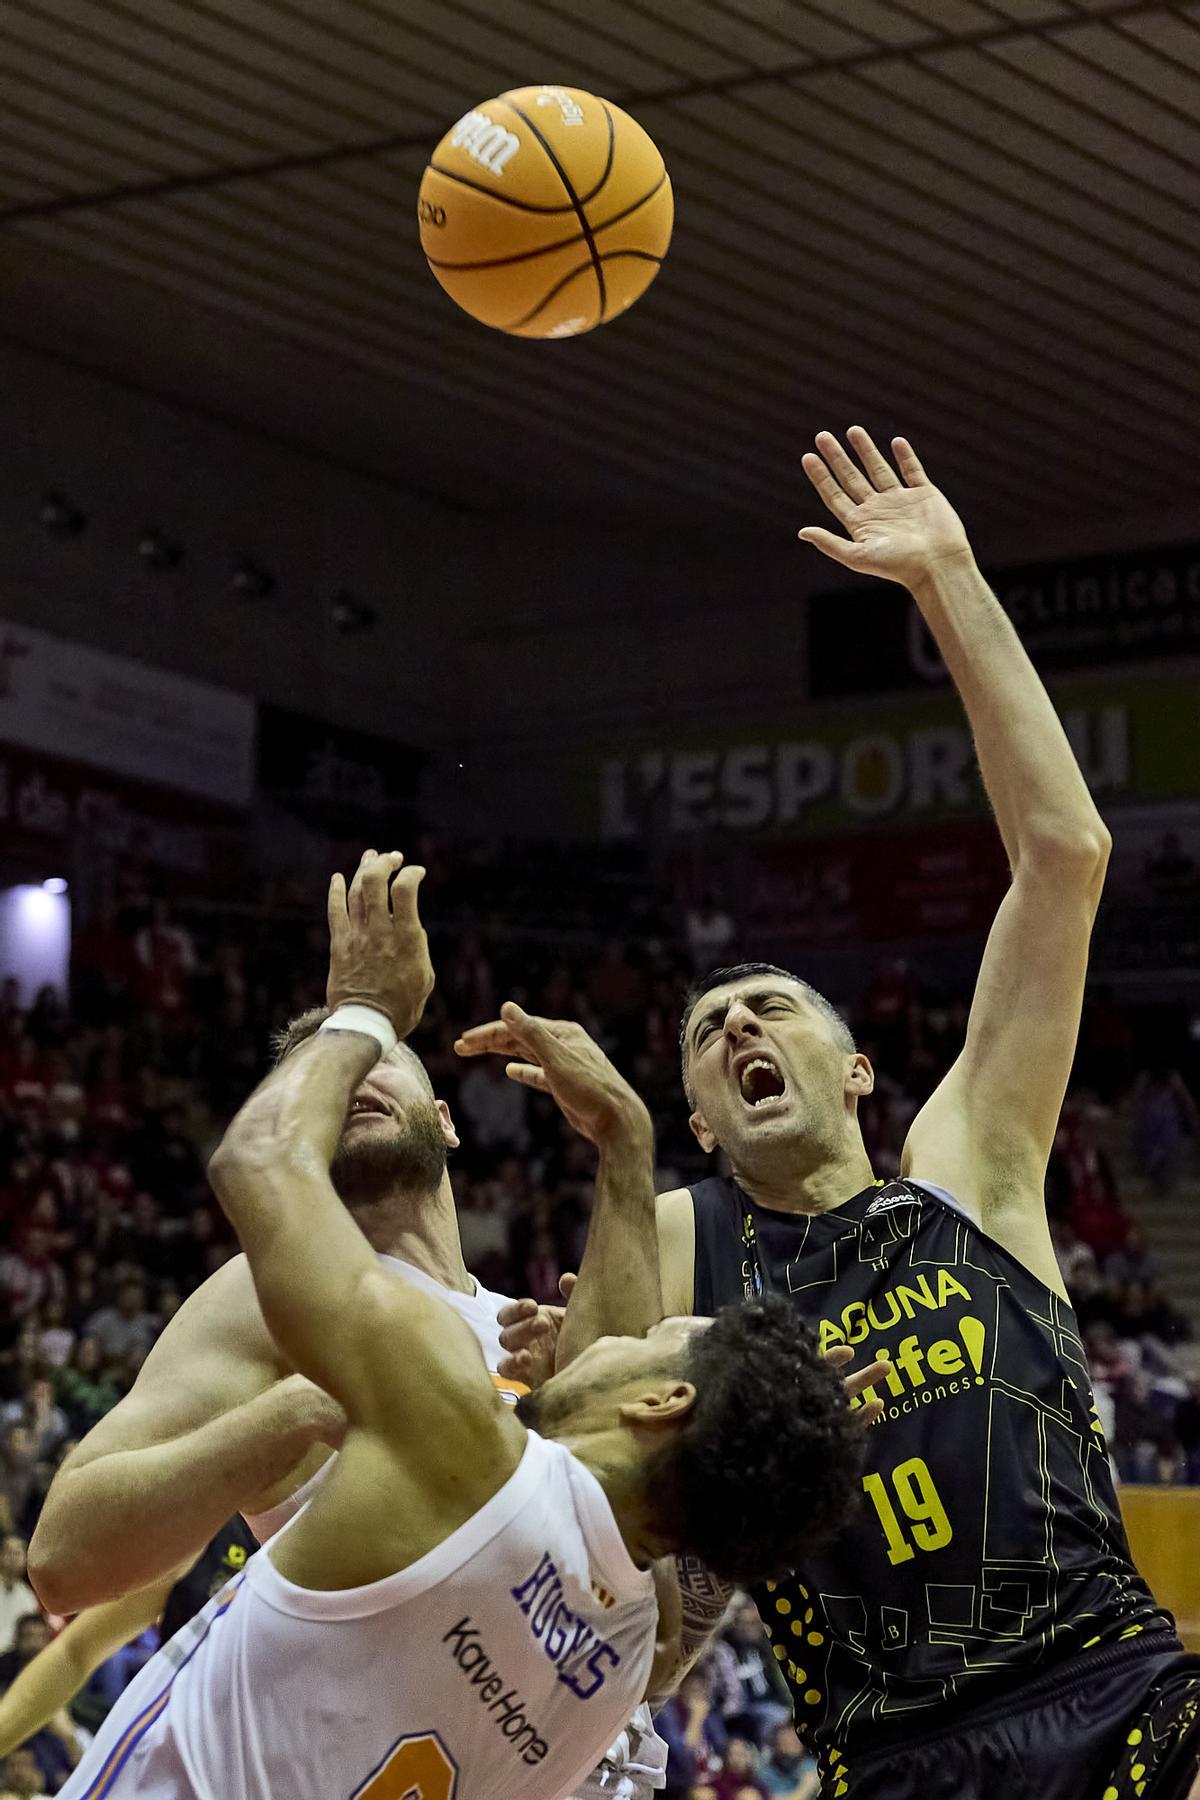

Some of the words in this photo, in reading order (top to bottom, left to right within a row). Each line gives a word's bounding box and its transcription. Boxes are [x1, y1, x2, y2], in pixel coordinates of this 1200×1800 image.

[598, 704, 1131, 839] L'ESPORU
[818, 1269, 972, 1357] AGUNA
[871, 1376, 971, 1426] mociones
[862, 1457, 953, 1566] 19
